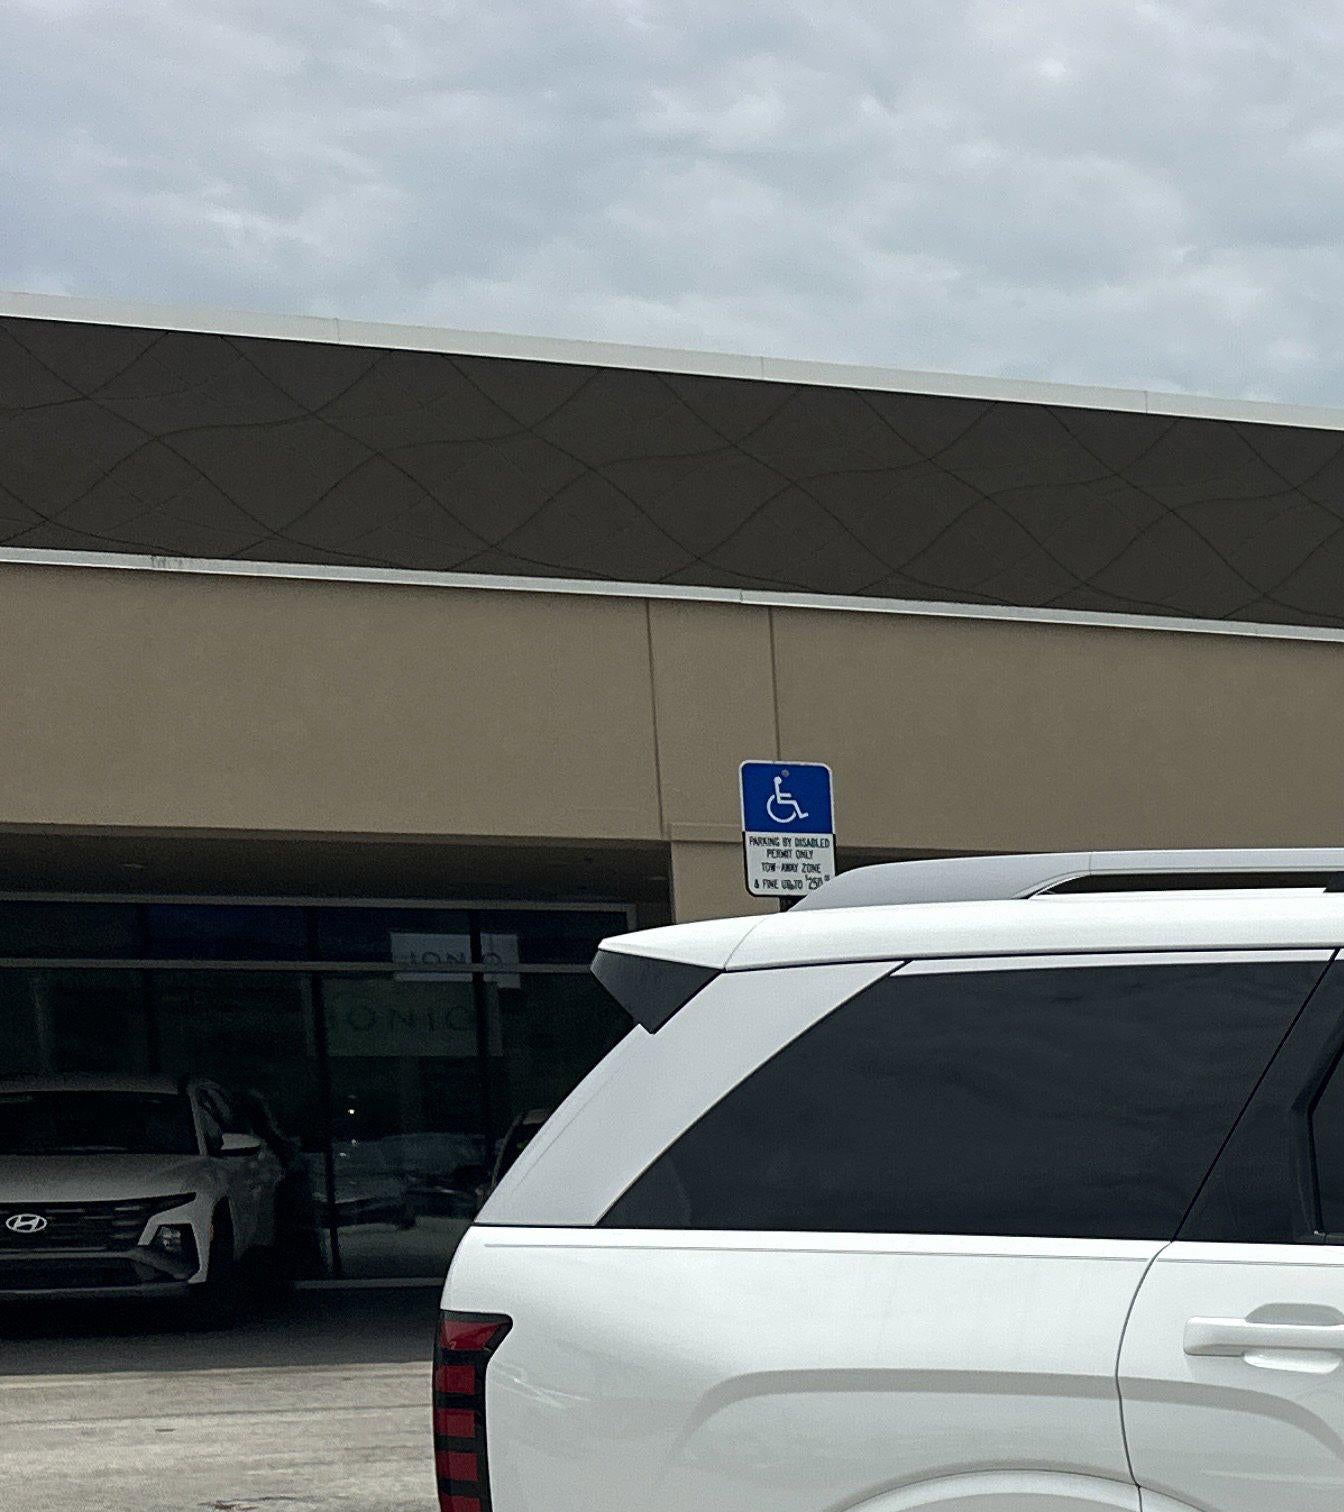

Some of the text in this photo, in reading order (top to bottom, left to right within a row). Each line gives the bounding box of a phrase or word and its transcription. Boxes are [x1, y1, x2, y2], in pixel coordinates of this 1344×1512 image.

[749, 836, 830, 847] PARKING BY DISABLED
[767, 849, 814, 860] PERMIT ONLY
[801, 863, 821, 874] ZONE
[763, 879, 779, 890] FINE
